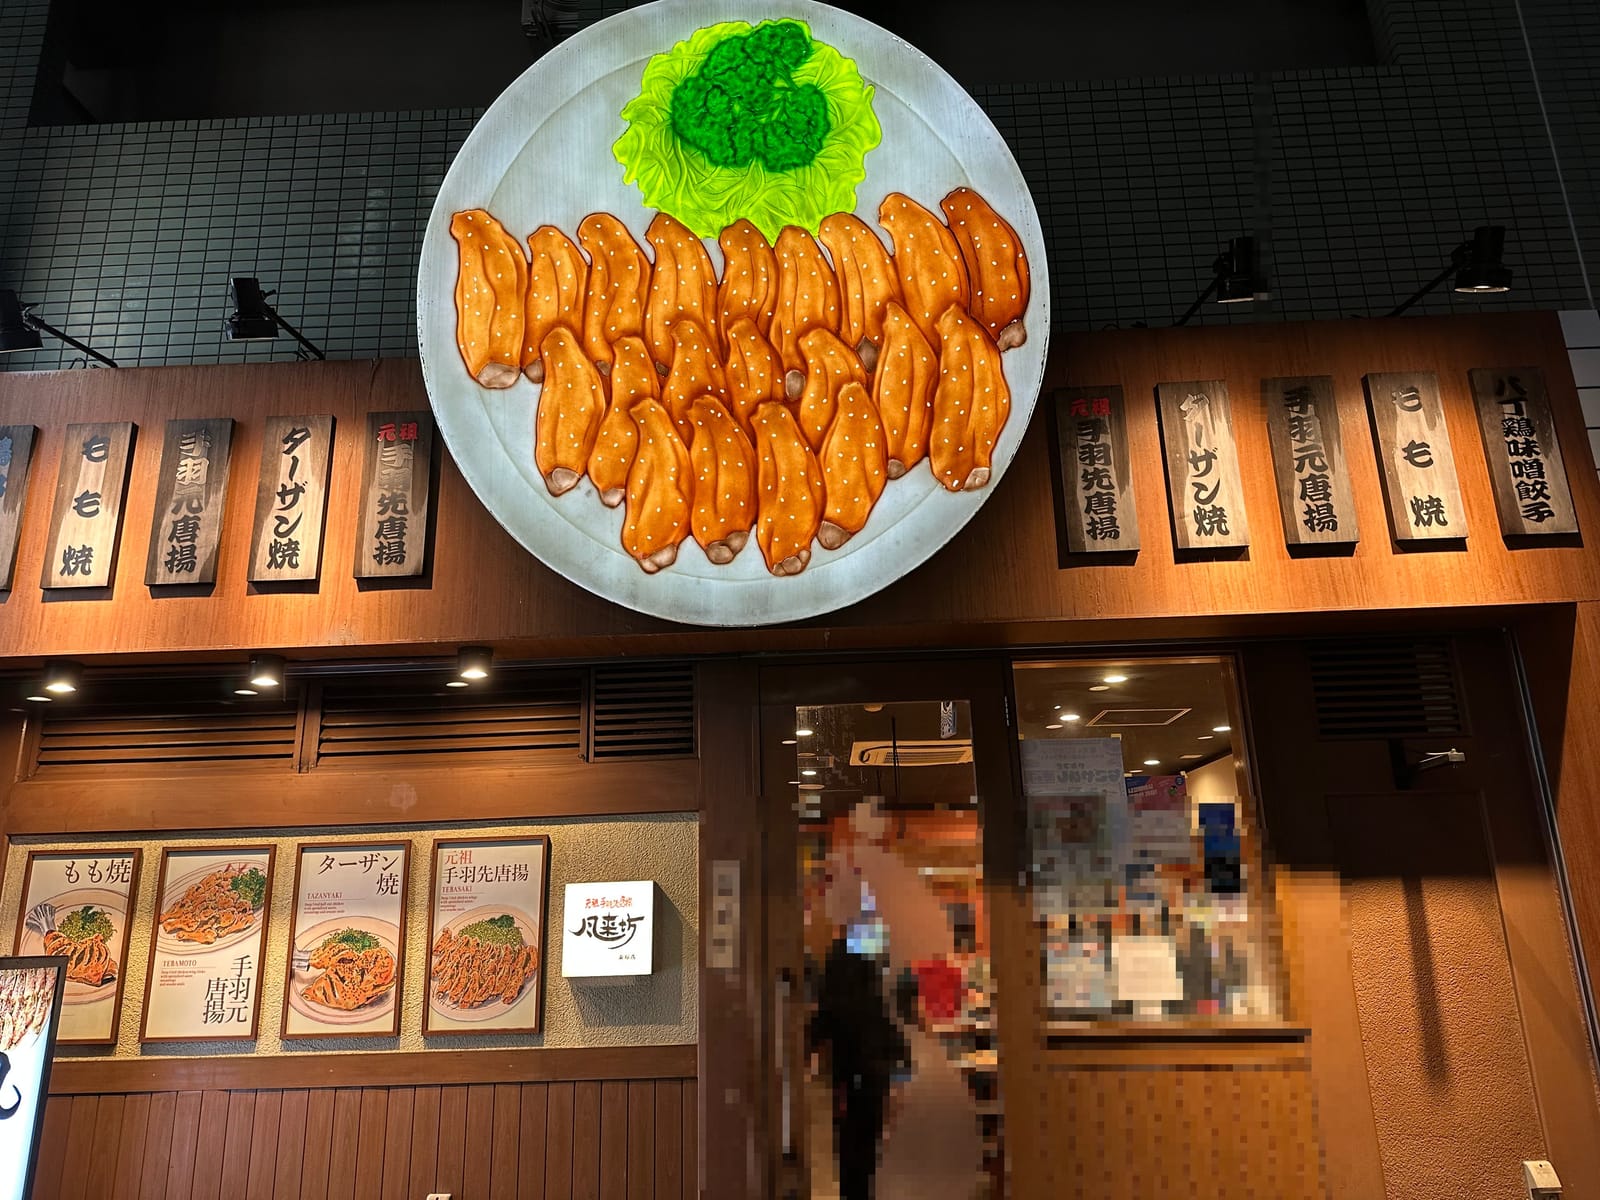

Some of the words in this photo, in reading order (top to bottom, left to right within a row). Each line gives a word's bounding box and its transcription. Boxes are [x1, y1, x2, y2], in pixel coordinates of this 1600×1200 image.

[377, 422, 418, 441] 元祖
[1071, 397, 1112, 417] 元祖
[1077, 418, 1120, 540] 手羽先唐揚
[1179, 393, 1230, 536] ターザン焼
[1284, 386, 1338, 532] 手羽元唐揚
[1392, 386, 1448, 527] もも焼
[60, 435, 111, 576] もも焼
[165, 429, 212, 573] 手羽元唐揚
[267, 427, 312, 570] ターザン焼
[373, 443, 413, 565] 手羽先唐揚
[65, 859, 131, 884] もも焼
[318, 853, 399, 875] ターザン
[375, 872, 399, 896] 焼
[441, 864, 529, 884] 手羽先唐揚
[444, 850, 472, 865] 元祖
[202, 977, 228, 1025] 唐揚
[225, 955, 252, 1024] 手羽元
